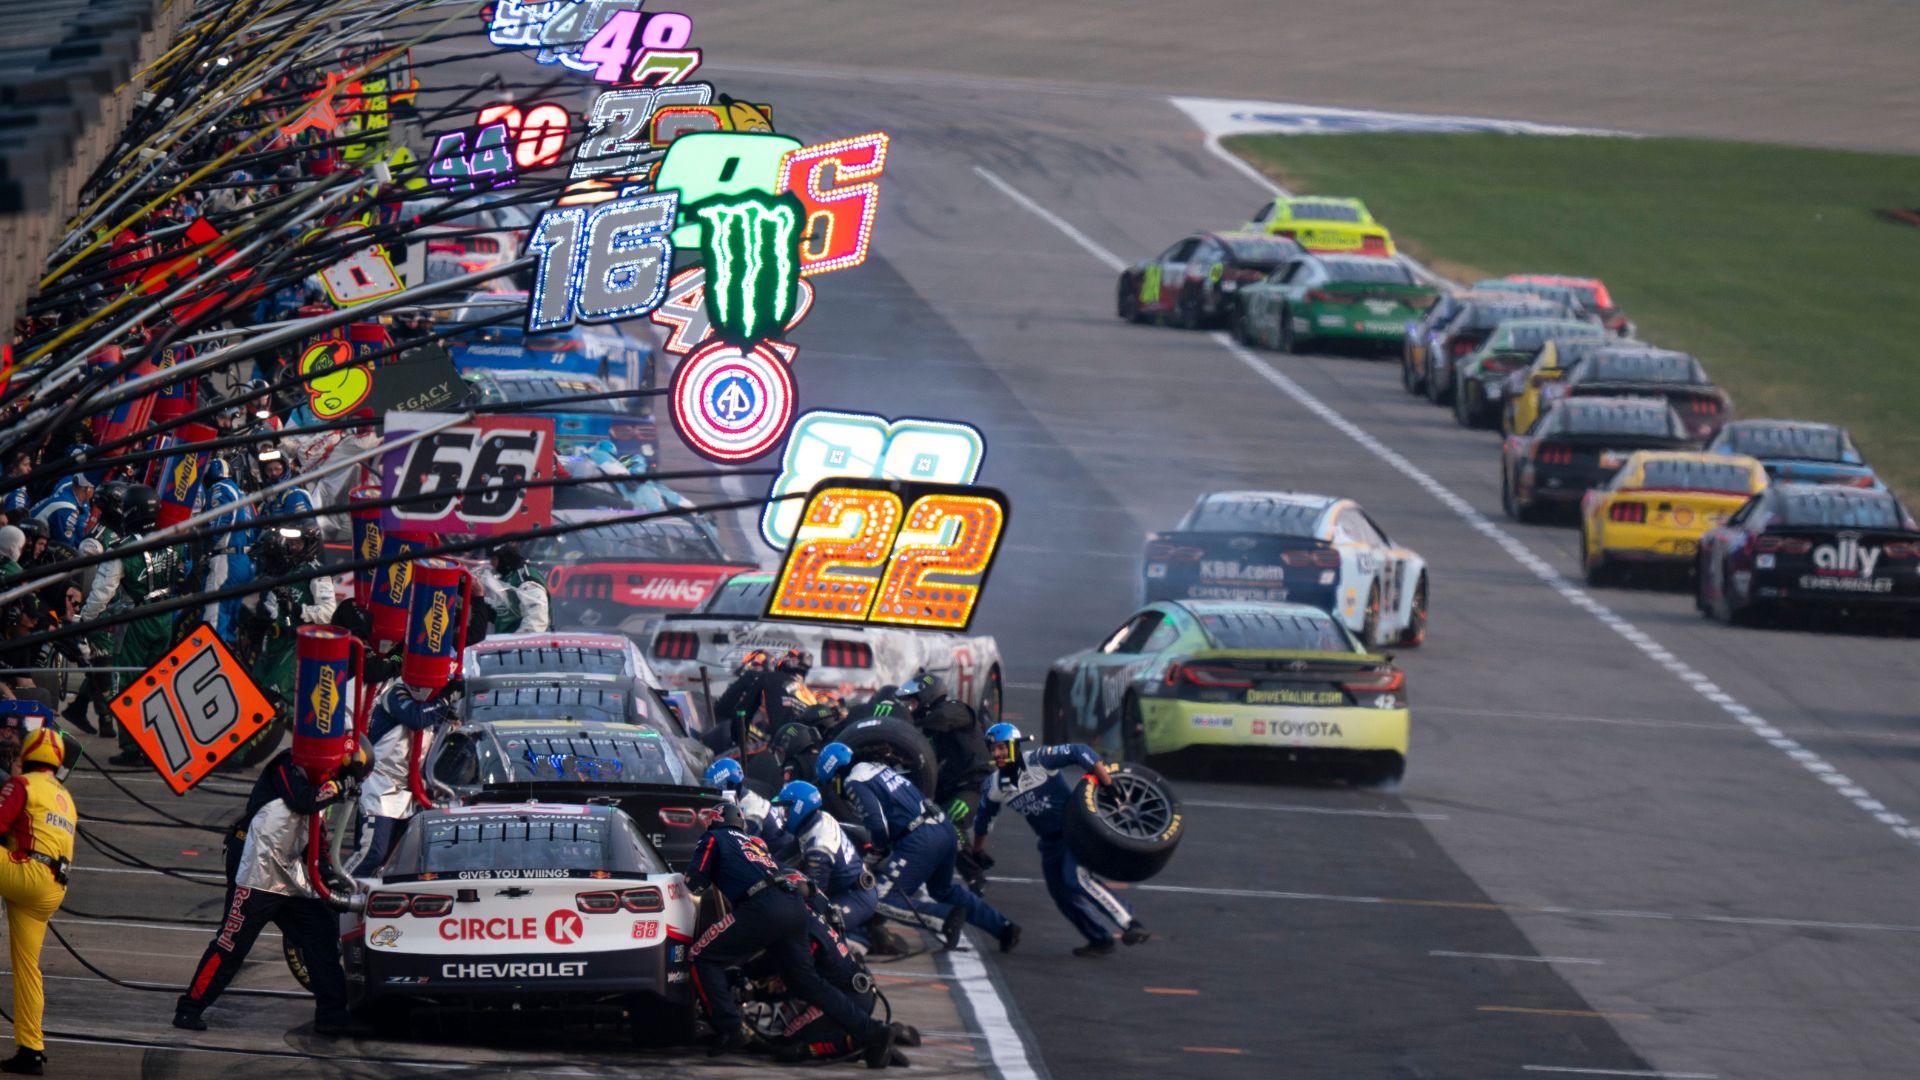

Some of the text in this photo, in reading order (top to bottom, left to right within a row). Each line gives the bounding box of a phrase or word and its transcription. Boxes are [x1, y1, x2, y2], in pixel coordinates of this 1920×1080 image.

[527, 190, 681, 333] 16
[651, 265, 815, 364] 4
[396, 382, 450, 412] EGACY
[391, 428, 546, 523] 66
[768, 487, 1004, 628] 22
[1814, 538, 1881, 578] ally
[630, 577, 714, 601] HAAS
[428, 594, 446, 652] SUNOCO
[141, 642, 240, 775] 16
[317, 666, 334, 733] SUNOCO
[1375, 695, 1396, 709] 42
[1268, 720, 1343, 737] TOYOTA
[458, 871, 492, 881] GIVES
[494, 869, 521, 880] YOU
[439, 917, 537, 941] CIRCLE
[631, 919, 660, 939] 88
[442, 961, 589, 979] CHEVROLET
